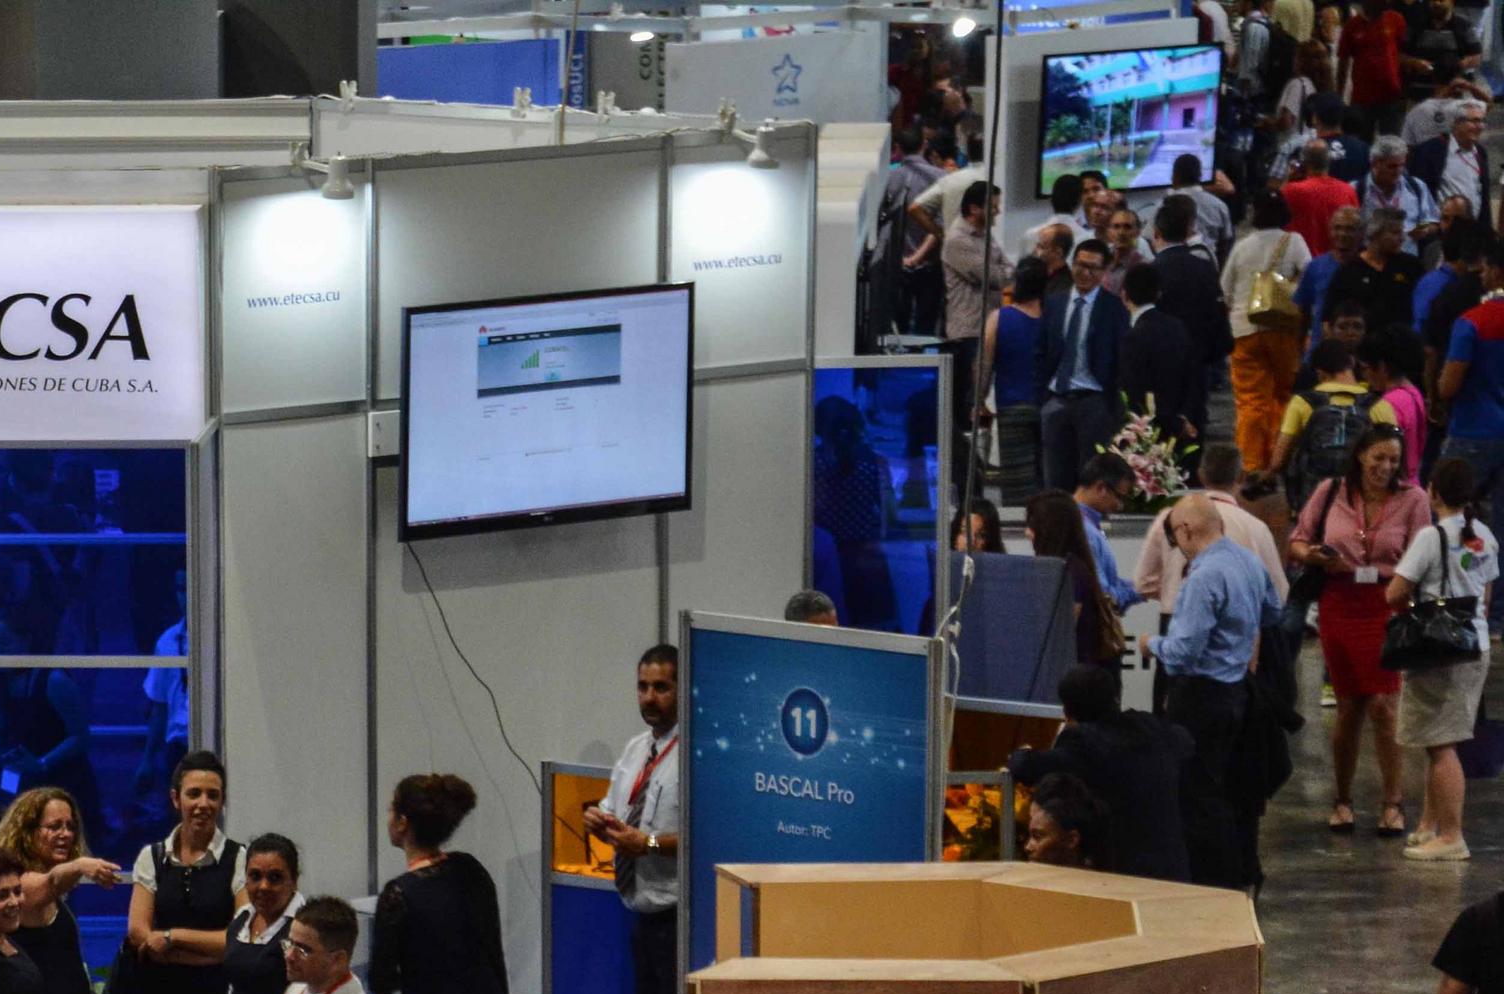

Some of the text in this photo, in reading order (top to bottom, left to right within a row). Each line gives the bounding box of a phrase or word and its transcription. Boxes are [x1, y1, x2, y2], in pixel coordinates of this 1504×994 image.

[692, 253, 783, 271] www.etecsa.cu
[246, 289, 341, 308] www.etecsa.cu
[43, 377, 68, 393] DE
[70, 378, 122, 394] CUBA
[126, 378, 159, 394] S.A.
[790, 706, 817, 739] 11
[754, 771, 855, 804] BASCAL Pro
[776, 819, 832, 840] Autor: TPC
